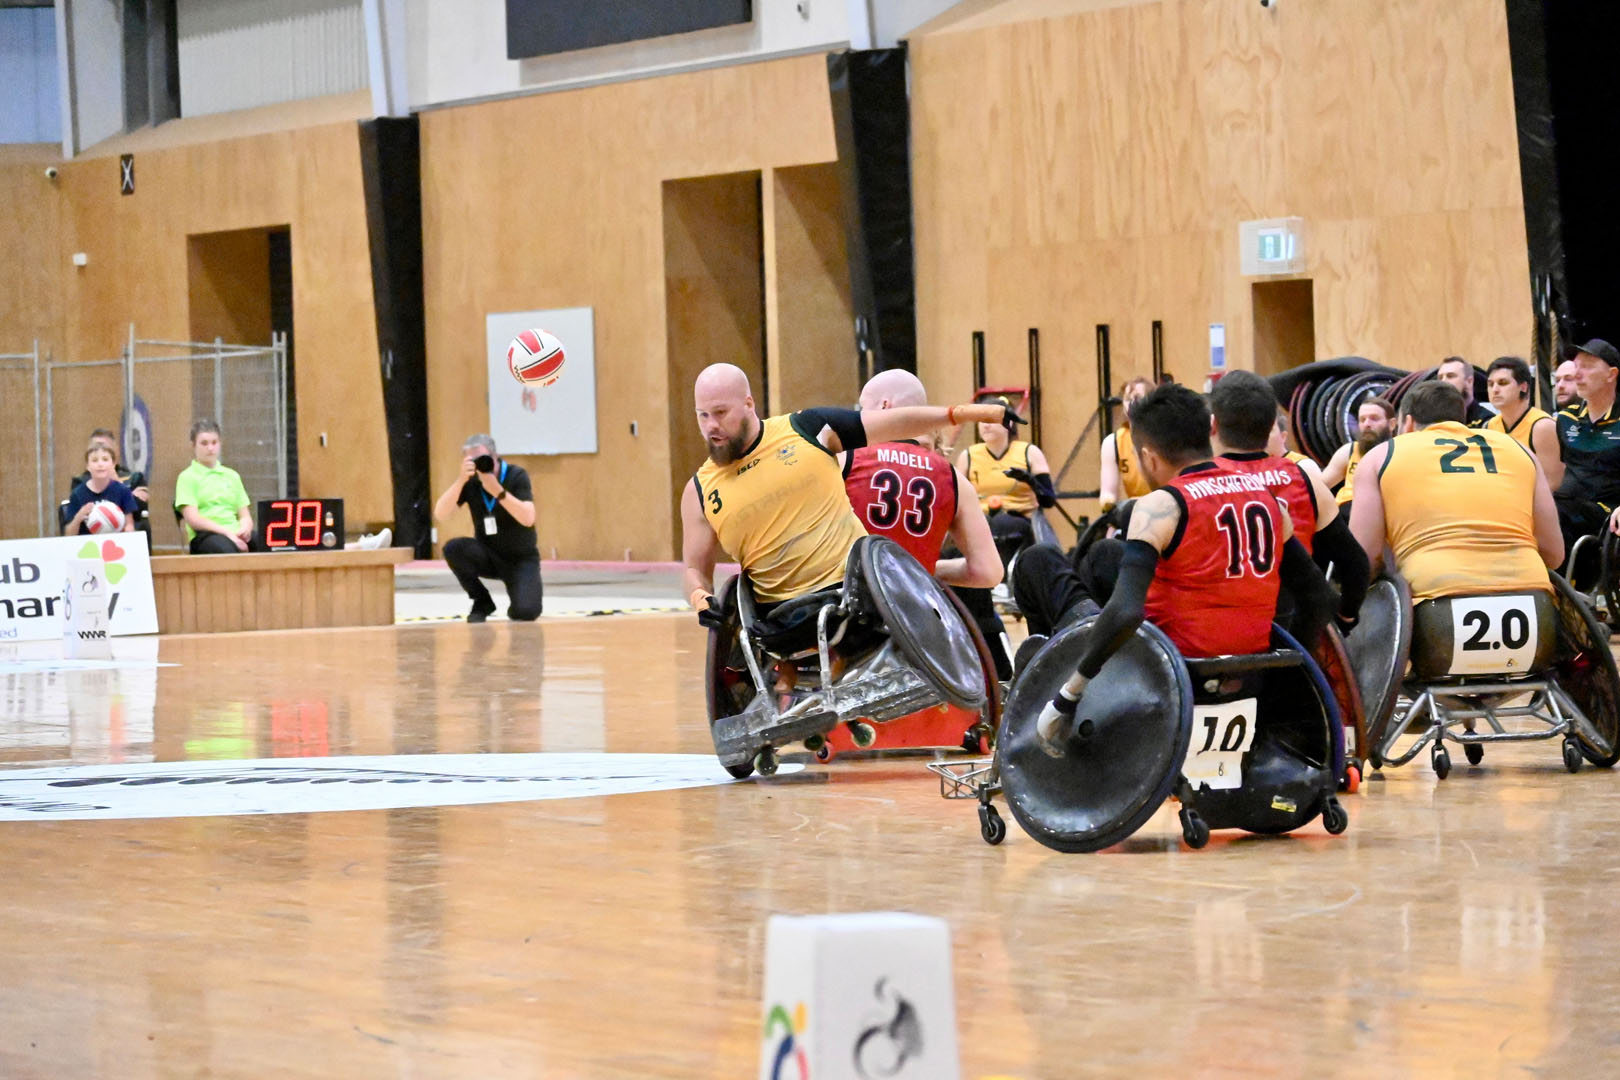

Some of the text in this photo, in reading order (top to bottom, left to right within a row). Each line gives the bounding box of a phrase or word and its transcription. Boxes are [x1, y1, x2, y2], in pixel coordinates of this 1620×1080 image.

[877, 448, 934, 471] MADELL
[1434, 434, 1498, 473] 21
[708, 489, 723, 514] 3
[867, 468, 936, 537] 33
[266, 501, 322, 547] 28
[1215, 501, 1275, 578] 10
[1463, 608, 1529, 651] 2.0
[1197, 714, 1247, 756] 1.0
